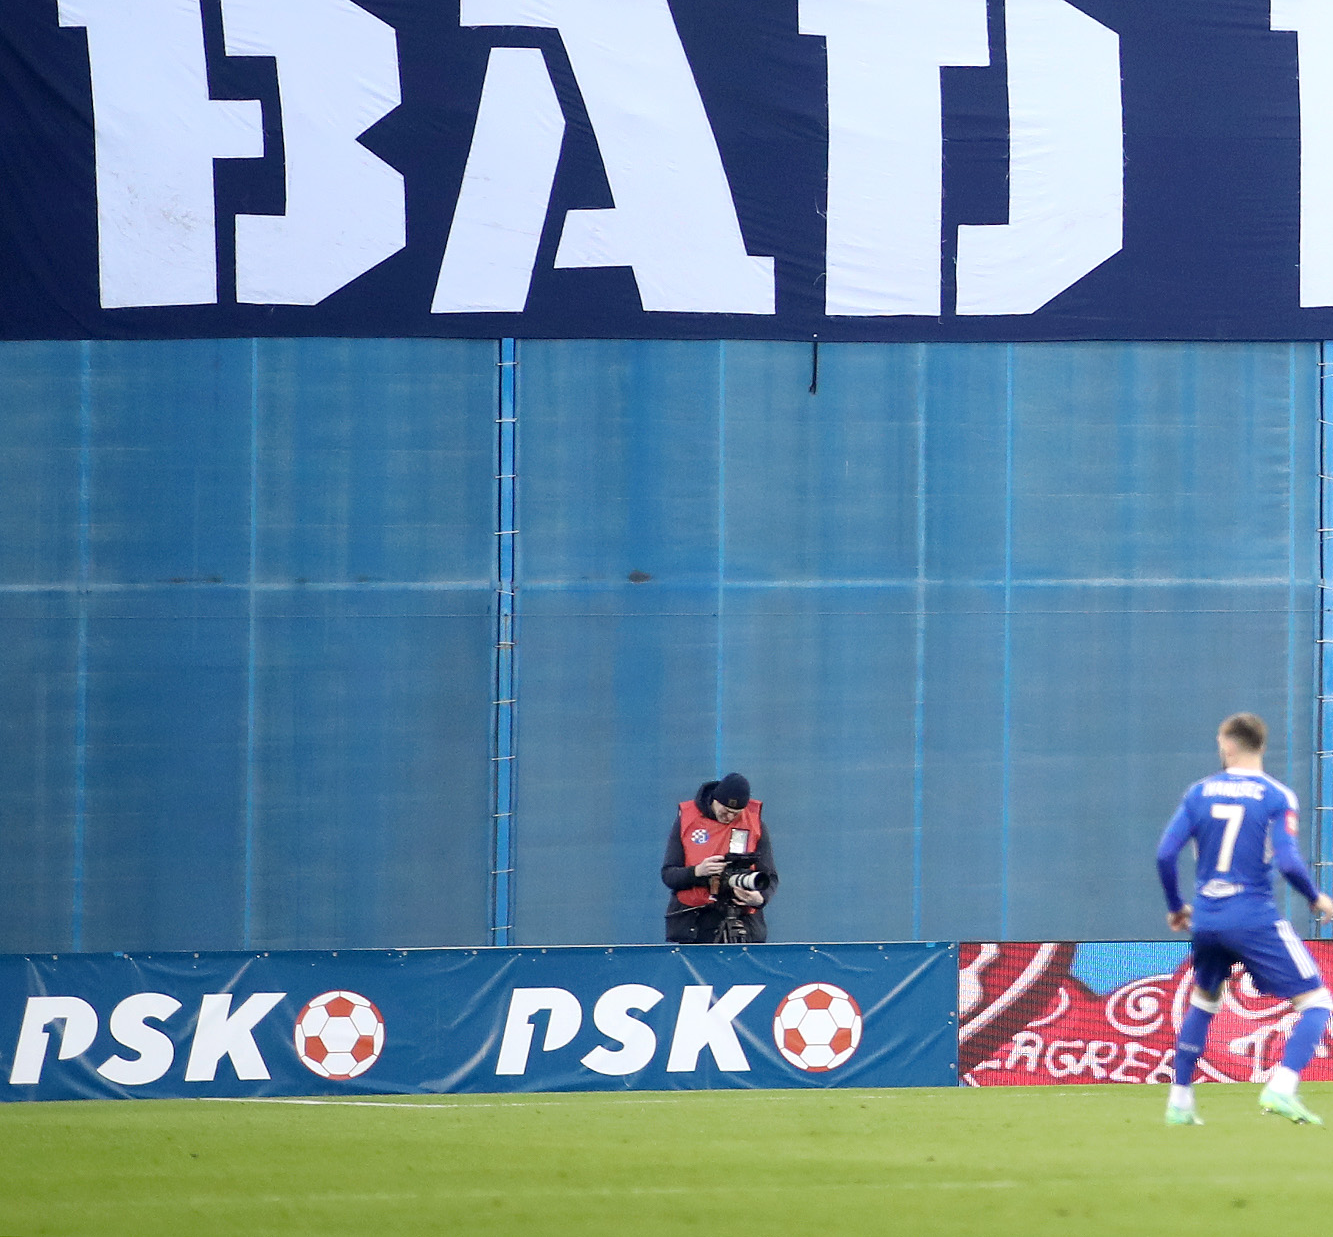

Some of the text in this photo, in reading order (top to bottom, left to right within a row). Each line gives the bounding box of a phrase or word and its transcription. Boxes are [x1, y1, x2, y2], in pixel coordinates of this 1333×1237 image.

[1211, 804, 1245, 873] 7
[9, 992, 288, 1086] PSK
[494, 983, 767, 1077] PSK
